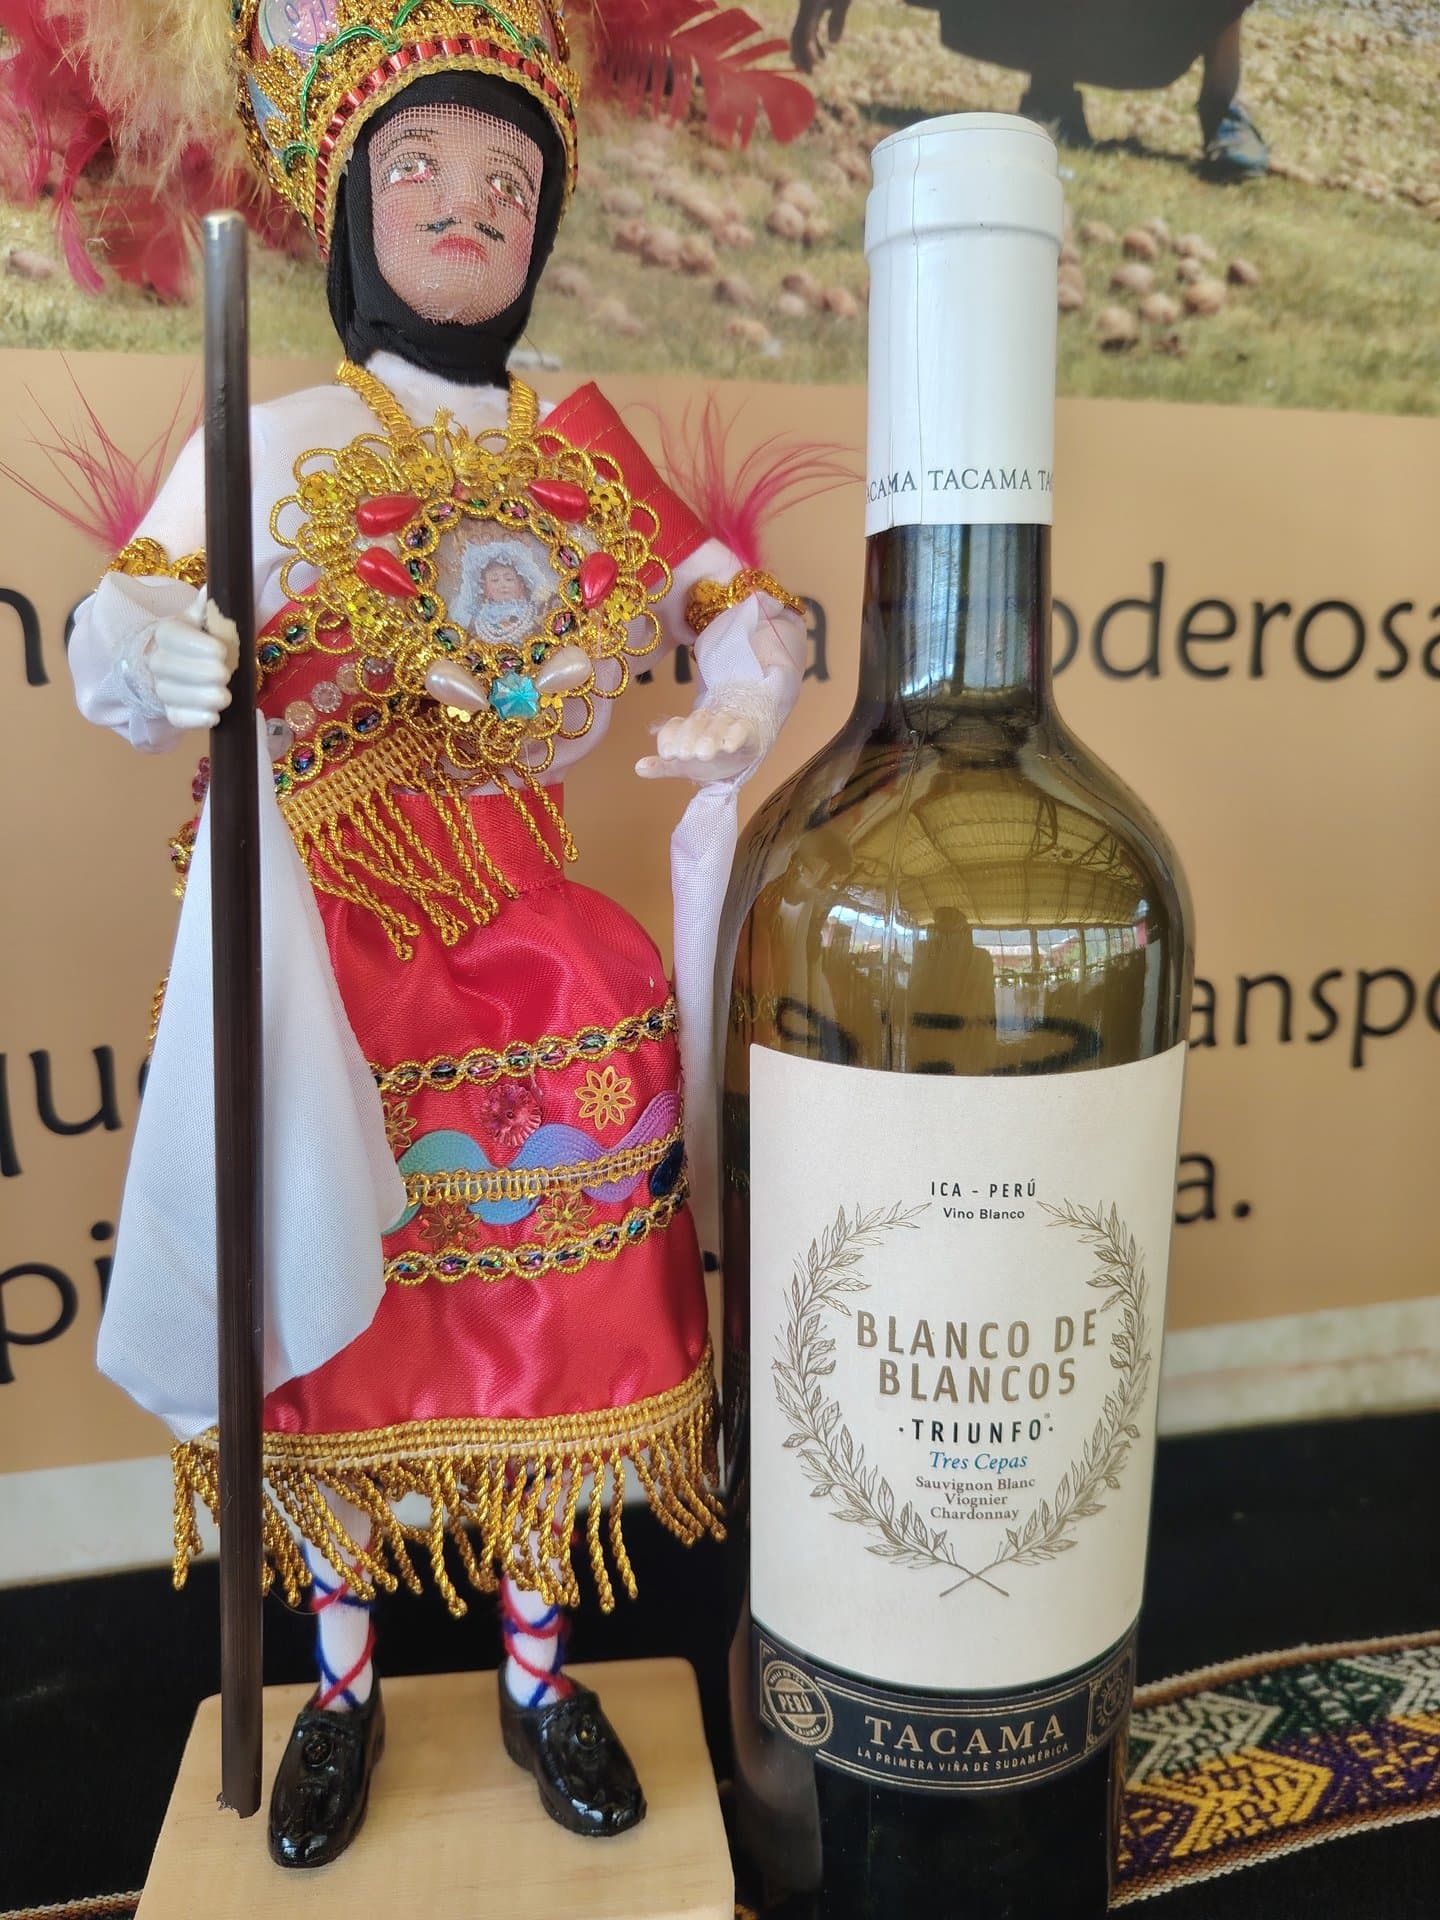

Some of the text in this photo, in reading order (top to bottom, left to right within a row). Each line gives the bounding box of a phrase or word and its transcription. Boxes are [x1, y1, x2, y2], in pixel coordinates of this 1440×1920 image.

[928, 468, 1033, 491] TACAMA
[931, 1181, 962, 1198] ICA
[989, 1178, 1036, 1198] PERÚ
[943, 1207, 1025, 1220] Vino Blanco
[857, 1308, 1098, 1359] BLANCO DE
[879, 1357, 1076, 1404] BLANCOS
[929, 1451, 1028, 1474] Tres Cepas
[915, 1475, 1036, 1494] Sauvignon Blanc
[945, 1493, 1008, 1508] Viognier
[930, 1506, 1019, 1521] Chardonnay
[864, 1713, 1065, 1755] TACAMA
[857, 1746, 871, 1760] LA
[875, 1752, 934, 1771] PRIMERA
[973, 1761, 989, 1772] DE
